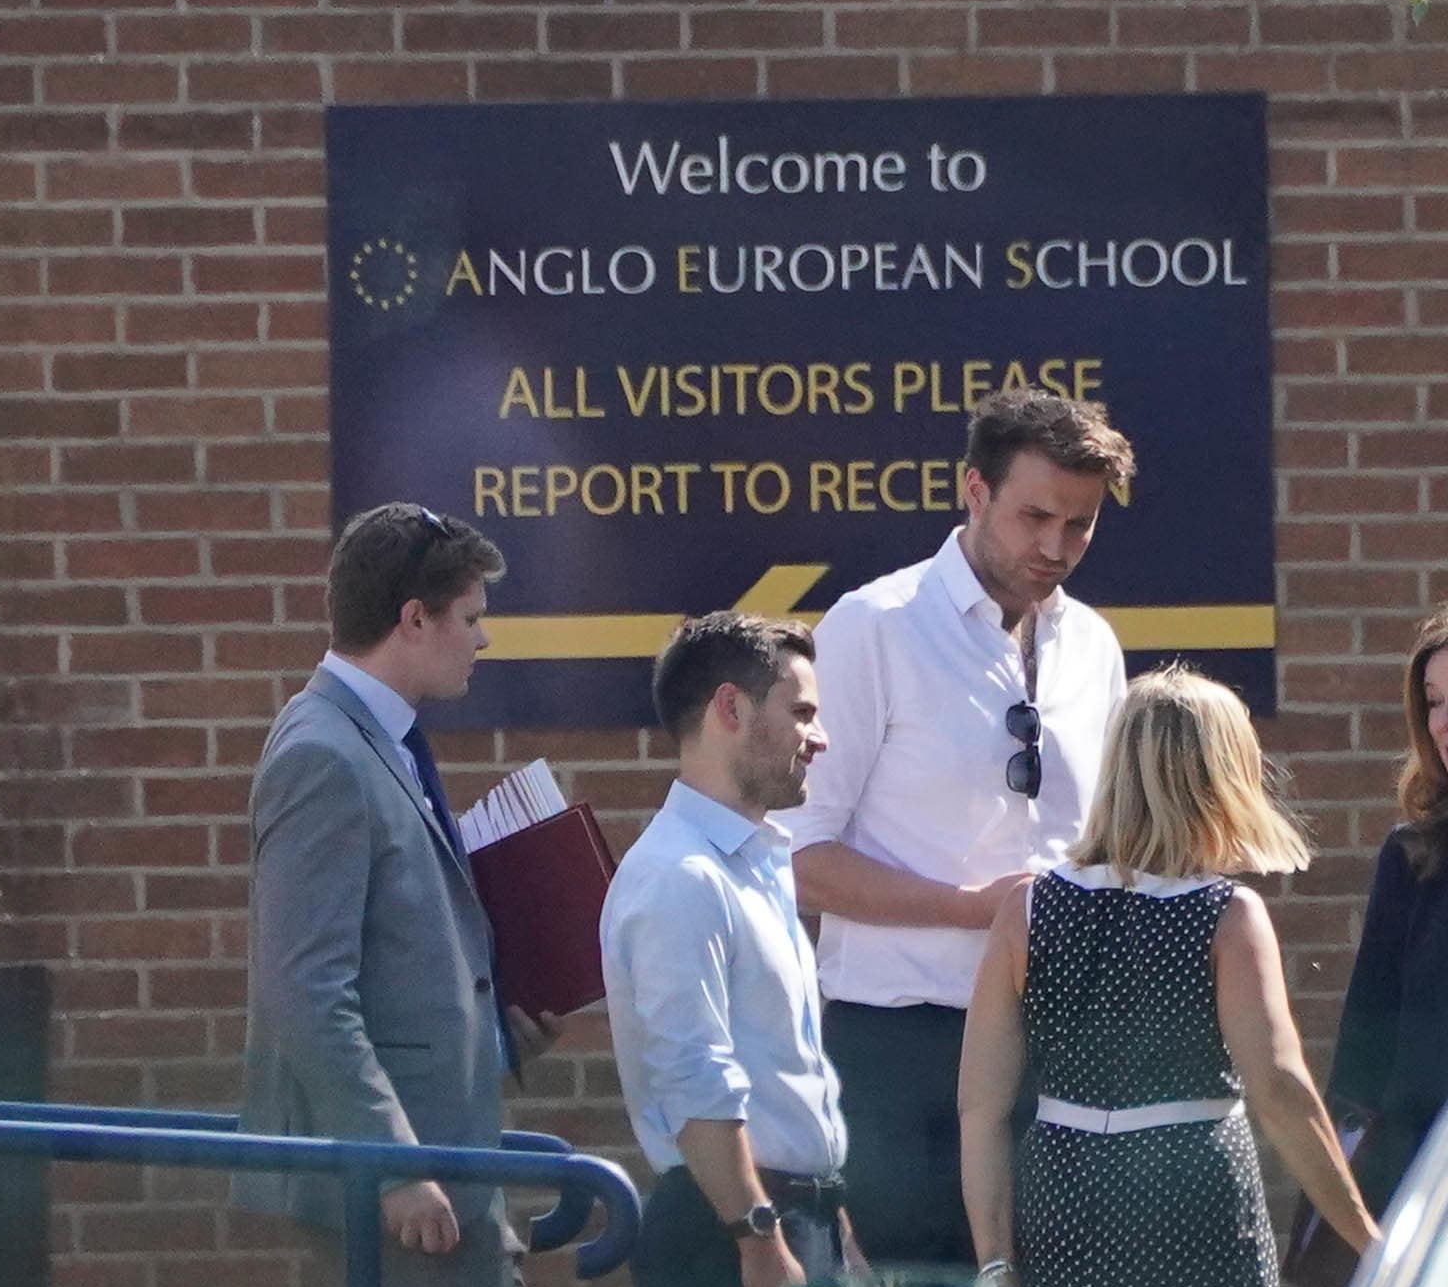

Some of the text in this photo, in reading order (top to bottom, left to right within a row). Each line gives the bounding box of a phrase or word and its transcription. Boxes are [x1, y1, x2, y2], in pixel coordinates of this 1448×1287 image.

[609, 135, 987, 195] Welcome to
[446, 239, 1247, 296] ANGLO EUROPEAN SCHOOL
[498, 359, 1102, 419] ALL VISITORS PLEASE
[474, 463, 700, 517] REPORT
[712, 462, 791, 513] TO
